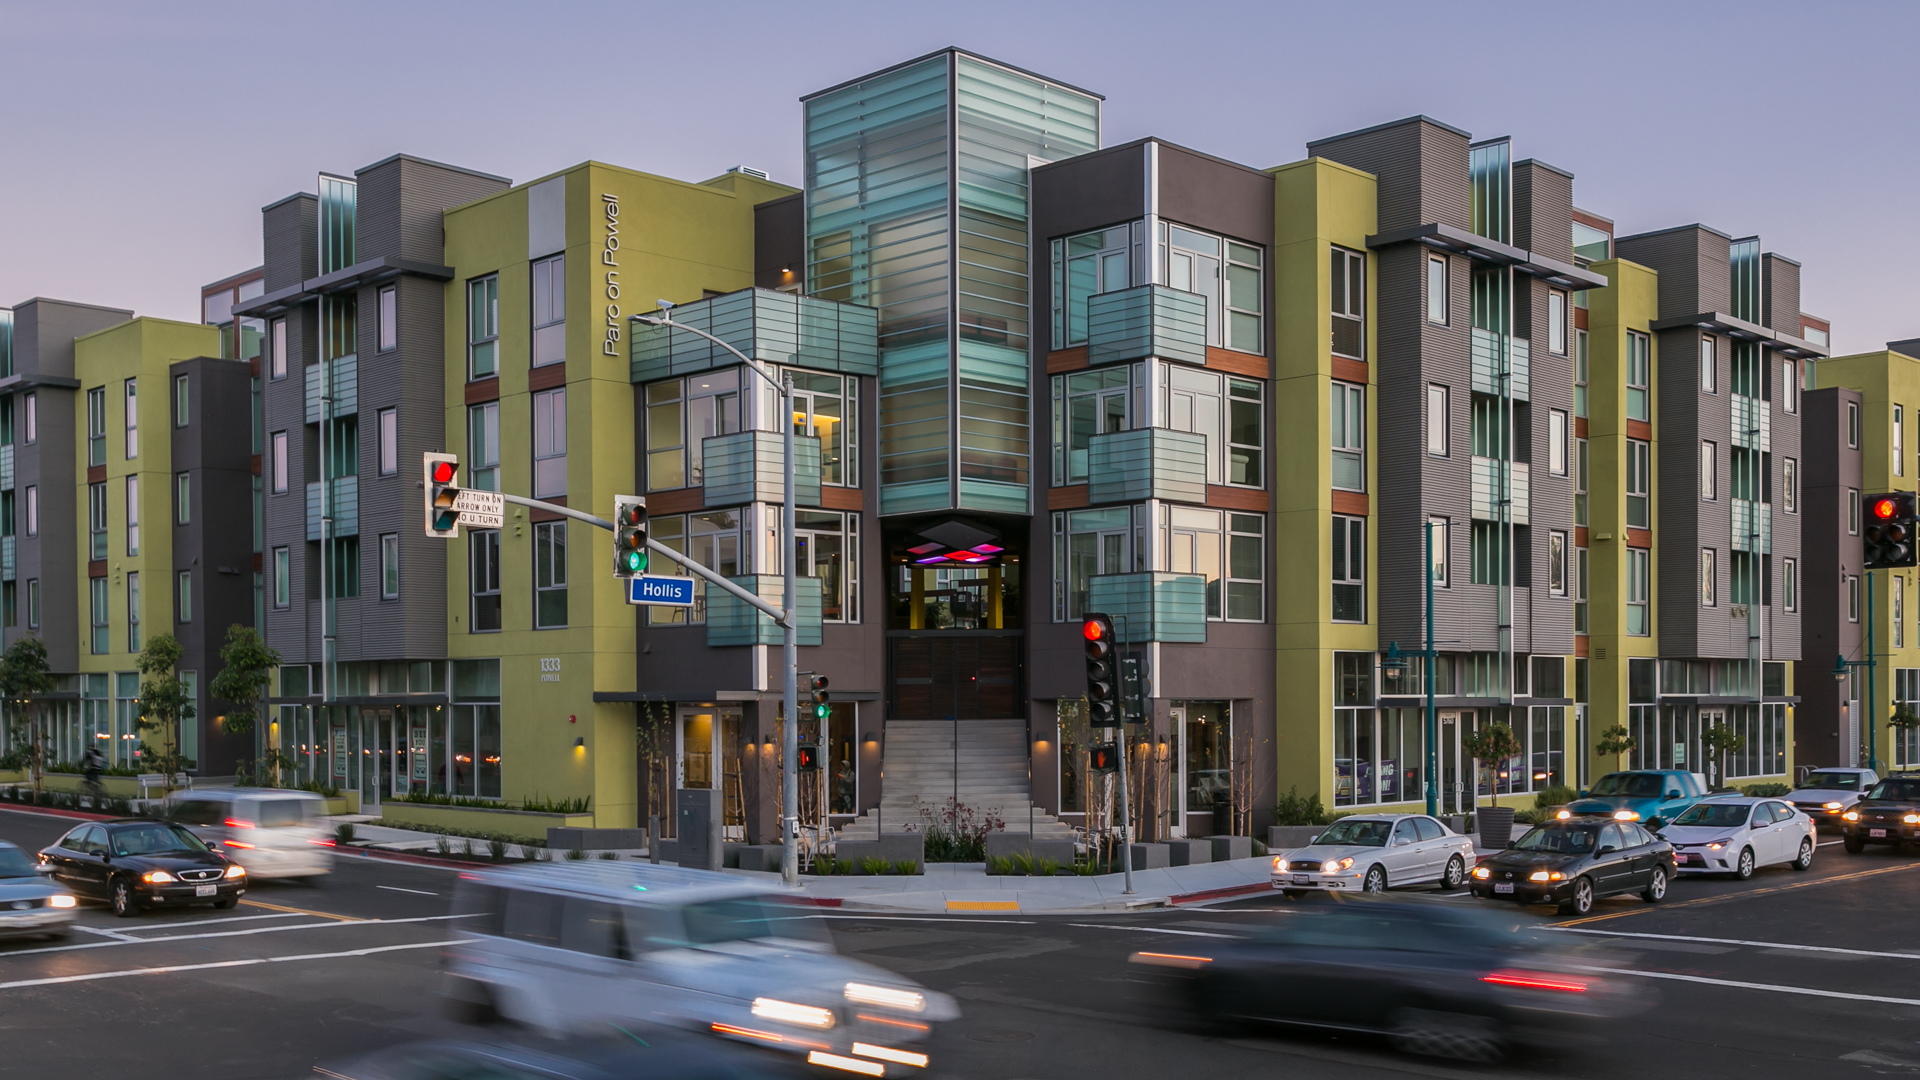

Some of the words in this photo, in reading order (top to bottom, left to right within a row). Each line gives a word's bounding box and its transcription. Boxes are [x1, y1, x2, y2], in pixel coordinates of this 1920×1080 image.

[602, 193, 620, 266] Powell
[606, 271, 620, 300] on
[603, 304, 620, 356] Parc
[458, 492, 470, 500] EFT
[473, 494, 490, 502] TURN
[492, 495, 501, 504] ON
[457, 502, 480, 511] ARROW
[482, 504, 499, 513] ONLY
[478, 515, 499, 524] TURN
[643, 582, 682, 598] Hollis
[540, 657, 561, 672] 1333
